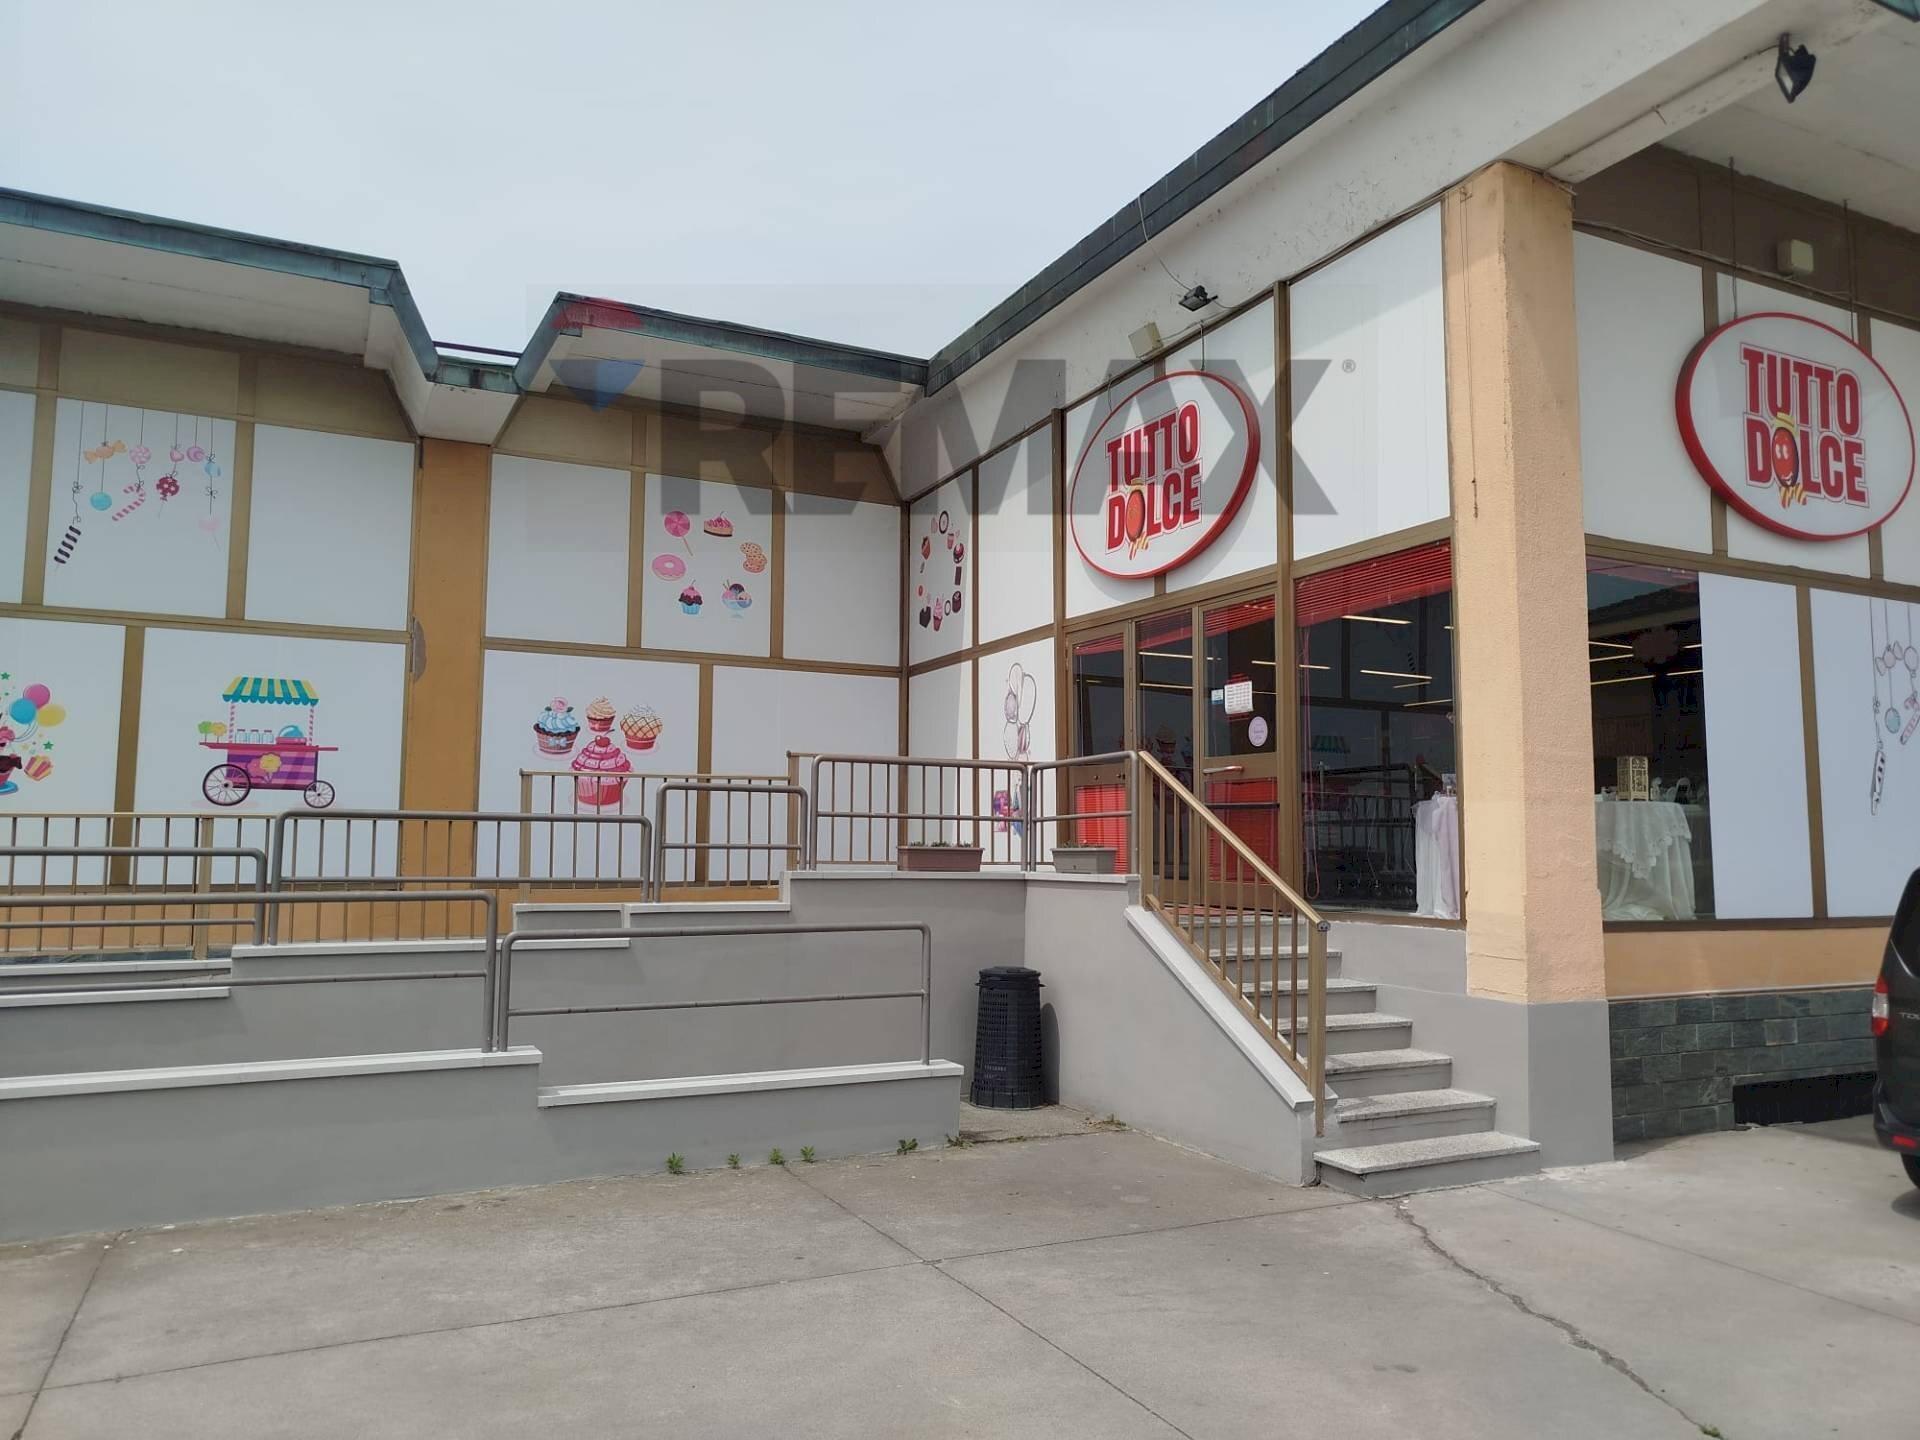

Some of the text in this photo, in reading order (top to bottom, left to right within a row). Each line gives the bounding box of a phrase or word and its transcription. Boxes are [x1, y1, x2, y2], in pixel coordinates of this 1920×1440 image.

[1740, 346, 1860, 436] TUTTO
[1107, 403, 1199, 493] TUTTO
[1745, 417, 1867, 504] DOLCE
[1107, 463, 1200, 550] DOLCE
